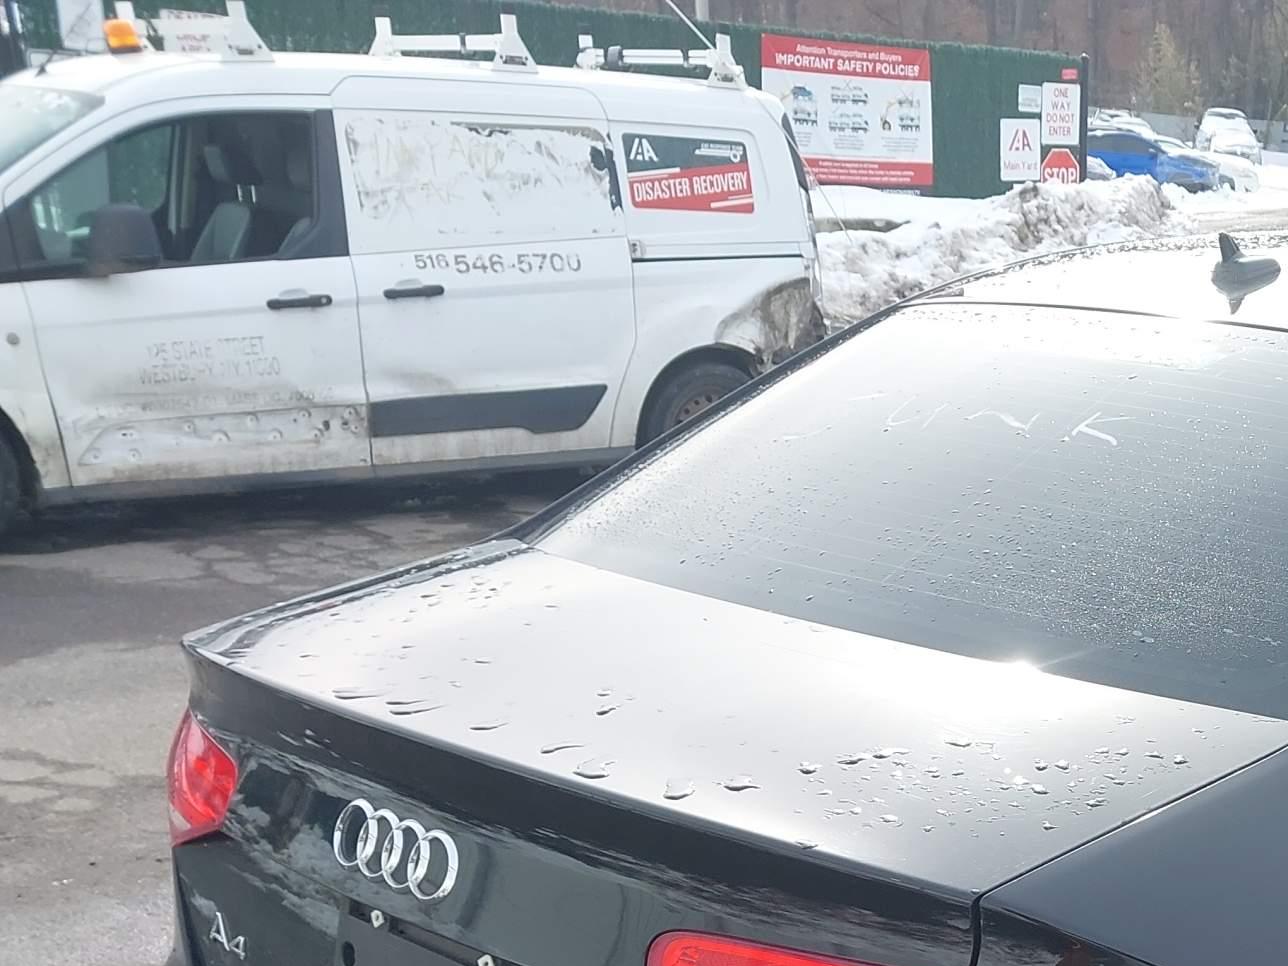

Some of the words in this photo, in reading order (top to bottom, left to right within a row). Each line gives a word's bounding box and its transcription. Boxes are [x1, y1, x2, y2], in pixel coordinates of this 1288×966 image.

[775, 53, 834, 70] IMPORTANT
[837, 58, 874, 74] SAFETY
[875, 61, 920, 77] POLICIES
[1053, 87, 1069, 98] ONE
[1051, 102, 1071, 111] WAY
[1046, 113, 1058, 123] DO
[1059, 113, 1075, 123] NOT
[1048, 126, 1072, 136] ENTER
[1044, 167, 1077, 184] STOP
[633, 177, 690, 202] DISASTER
[692, 171, 748, 196] RECOVERY
[414, 254, 449, 270] 516
[209, 911, 245, 960] A4
